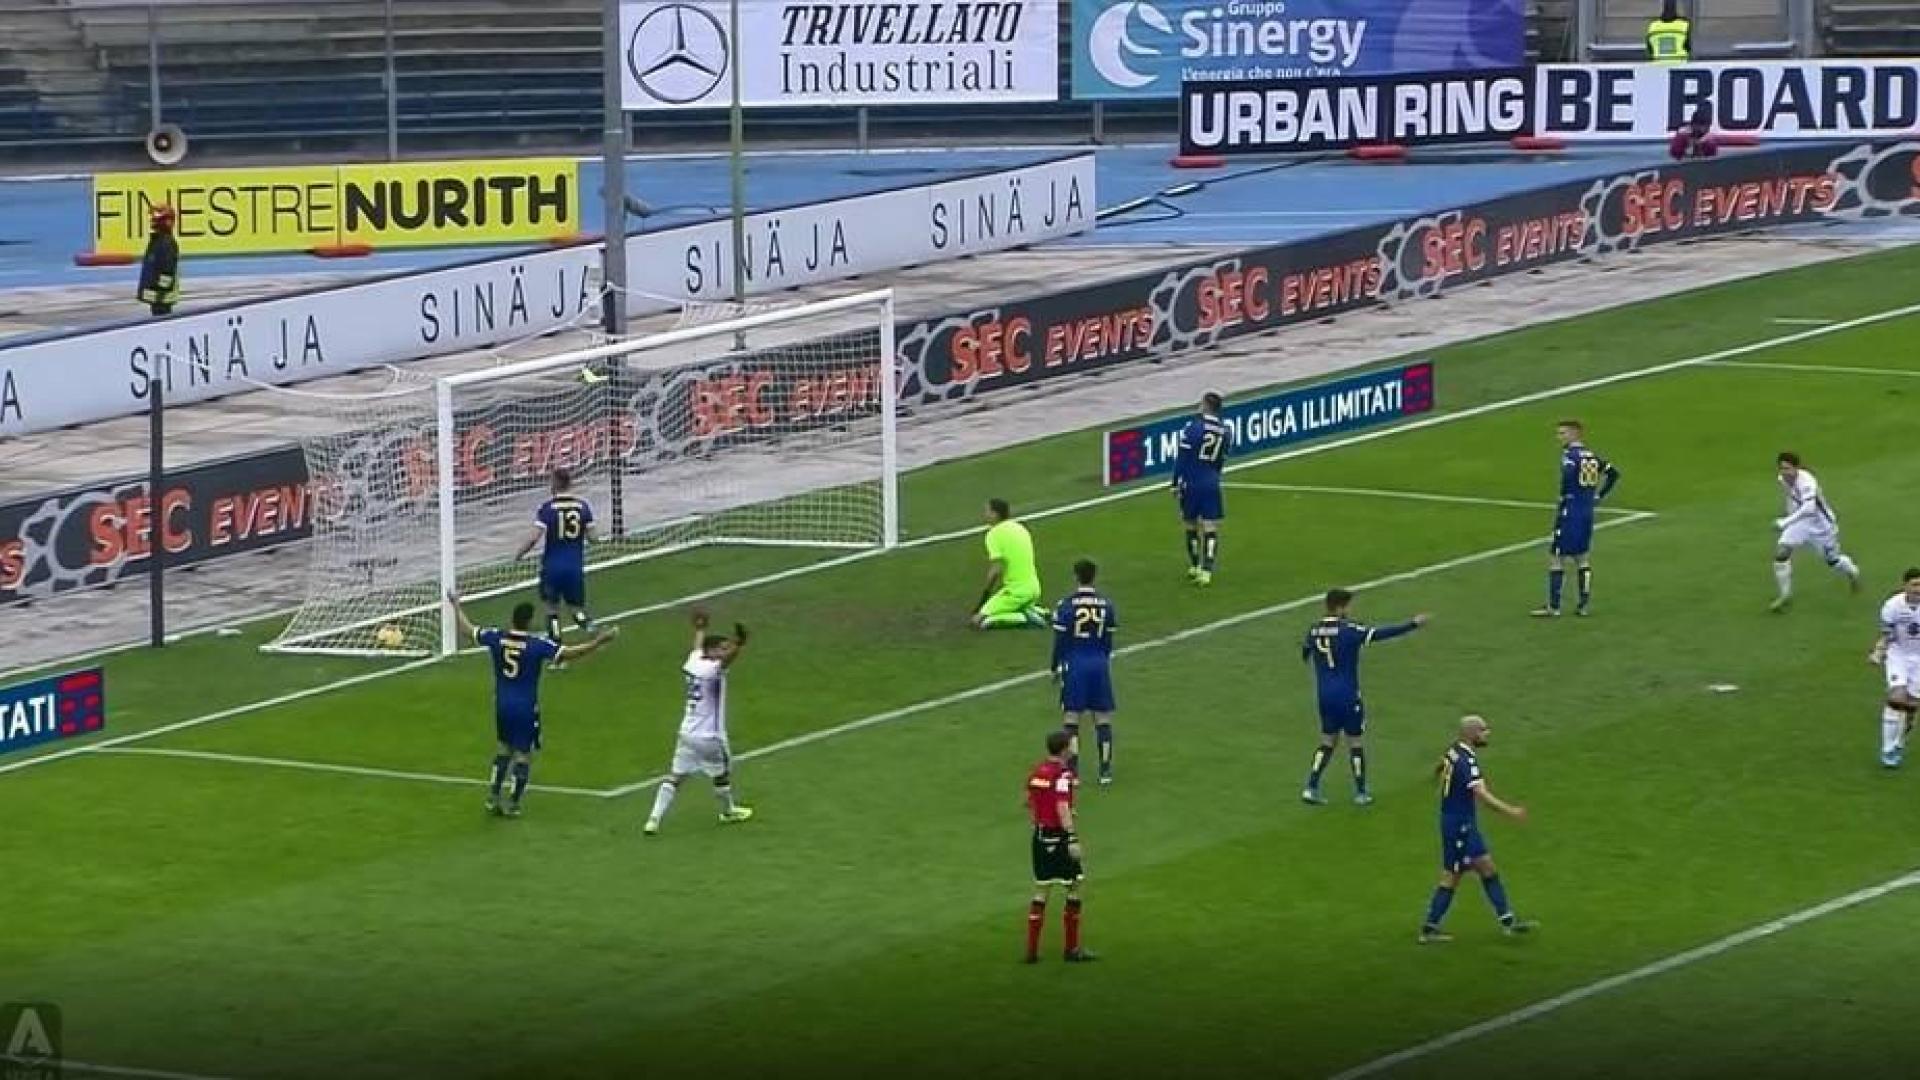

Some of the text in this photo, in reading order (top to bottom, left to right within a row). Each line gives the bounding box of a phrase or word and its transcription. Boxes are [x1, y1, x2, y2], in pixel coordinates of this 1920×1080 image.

[782, 2, 1023, 46] TRIVELLATO
[1182, 8, 1367, 67] Sinergy
[1228, 1, 1285, 16] Gruppo
[781, 50, 1013, 93] Industriali
[1545, 66, 1918, 132] BE BOARD
[1189, 79, 1525, 147] URBAN RING
[96, 173, 567, 240] FINESTRE NURITH
[930, 175, 1083, 249] SINÄ JA
[1621, 177, 1686, 237] SEC
[1693, 171, 1844, 227] EVENTS
[806, 218, 849, 271] JA
[1422, 210, 1585, 280] SEC EVENTS
[420, 264, 529, 343] SINÄ
[1196, 256, 1381, 332] SEC EVENTS
[273, 314, 323, 370] JA
[949, 305, 1153, 384] SEC EVENTS
[790, 361, 900, 420] EVENT
[1247, 404, 1297, 442] GIGA
[1302, 379, 1403, 431] ILLIMITATI
[88, 485, 193, 567] SEC
[558, 510, 580, 539] 13
[1074, 607, 1106, 639] 24
[1314, 635, 1335, 668] 4
[502, 647, 521, 679] 5
